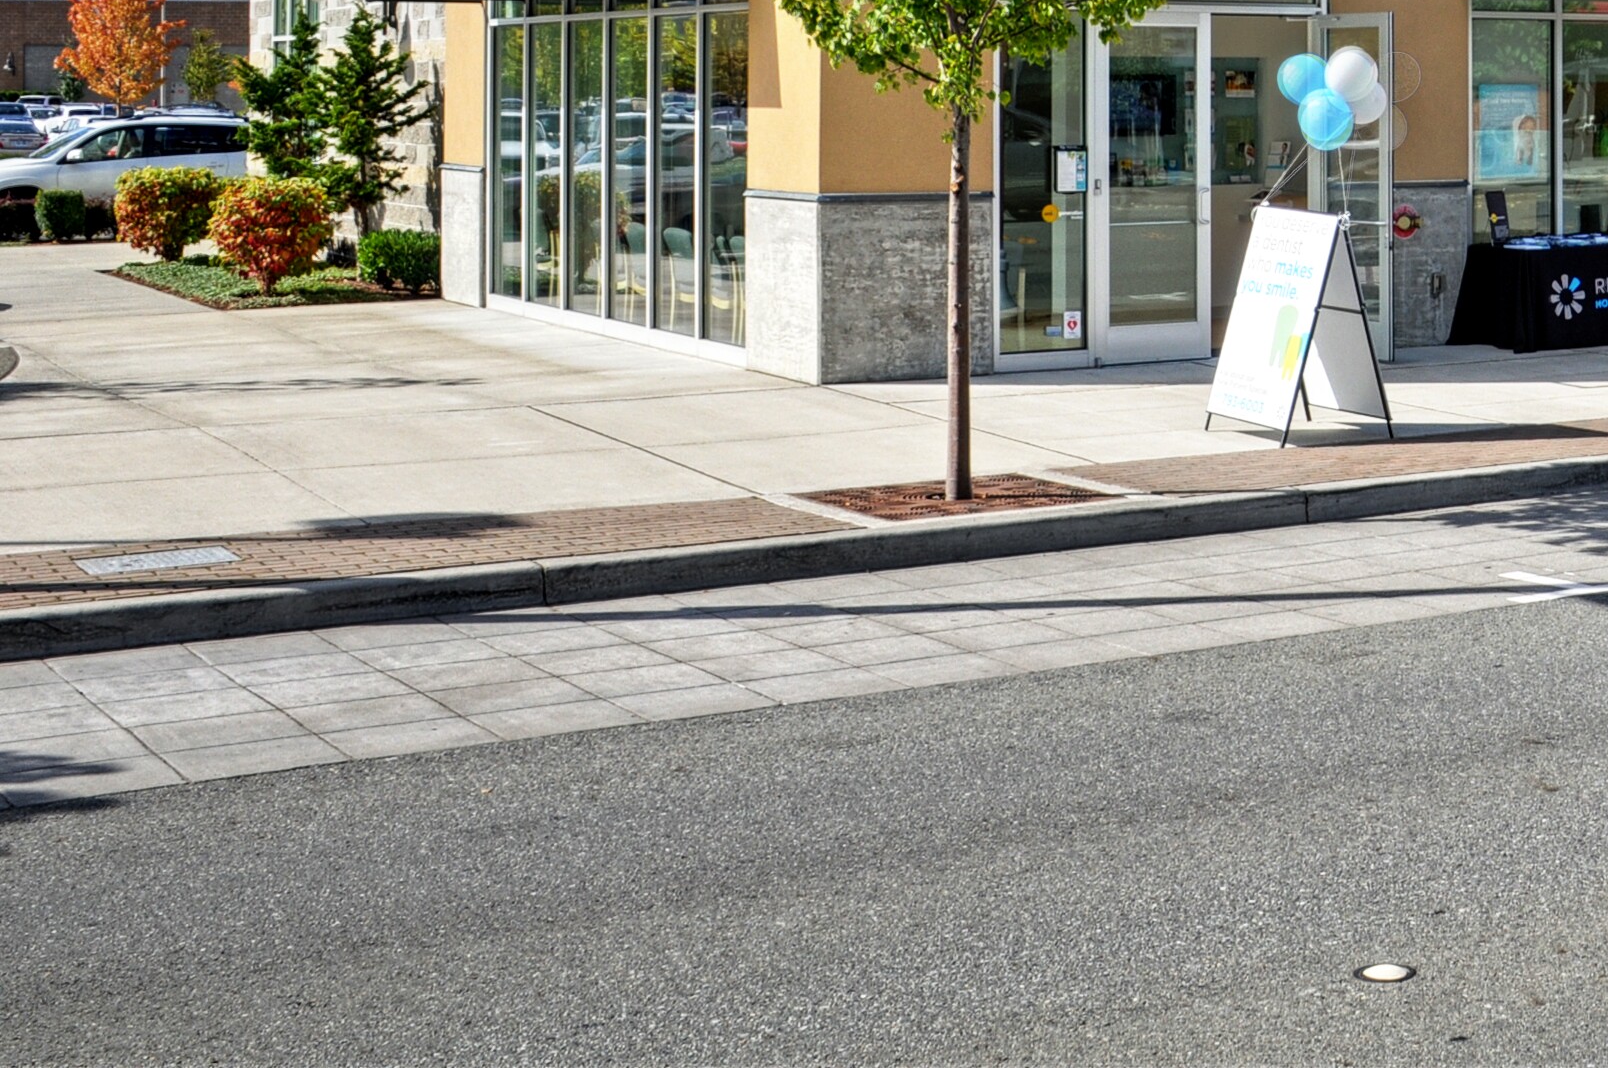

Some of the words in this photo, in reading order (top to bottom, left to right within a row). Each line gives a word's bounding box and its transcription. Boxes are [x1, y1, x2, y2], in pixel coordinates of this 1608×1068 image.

[1282, 216, 1330, 236] deserve
[1262, 233, 1304, 255] dentist
[1274, 259, 1314, 280] makes
[1241, 278, 1263, 294] you
[1264, 282, 1299, 300] smile.
